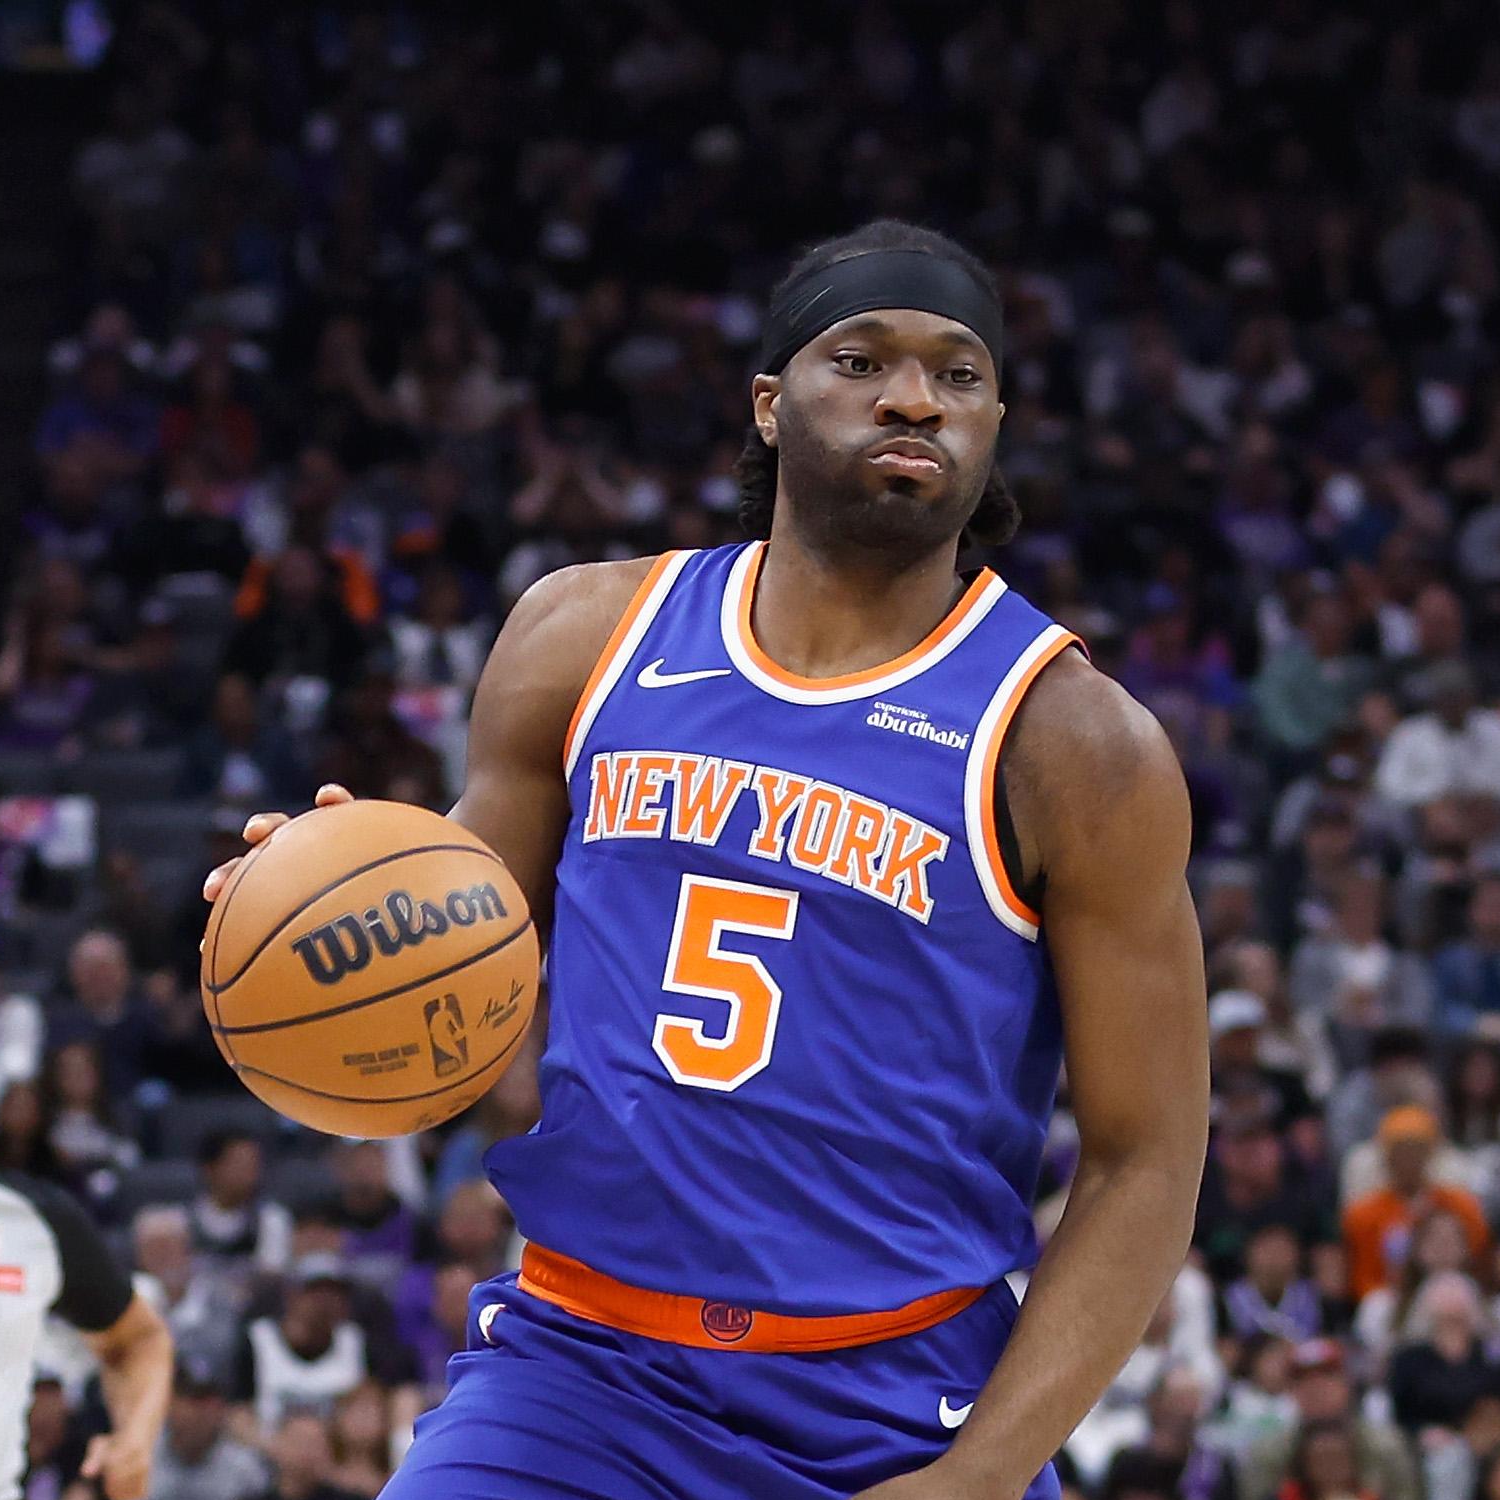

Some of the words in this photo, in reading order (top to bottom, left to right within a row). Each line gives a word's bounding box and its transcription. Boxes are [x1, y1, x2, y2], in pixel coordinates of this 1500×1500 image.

[866, 712, 908, 734] abu
[907, 720, 970, 751] dhabi
[873, 700, 929, 721] experience
[582, 750, 748, 846] NEW
[748, 764, 951, 926] YORK
[291, 880, 509, 987] Wilson
[651, 872, 800, 1093] 5
